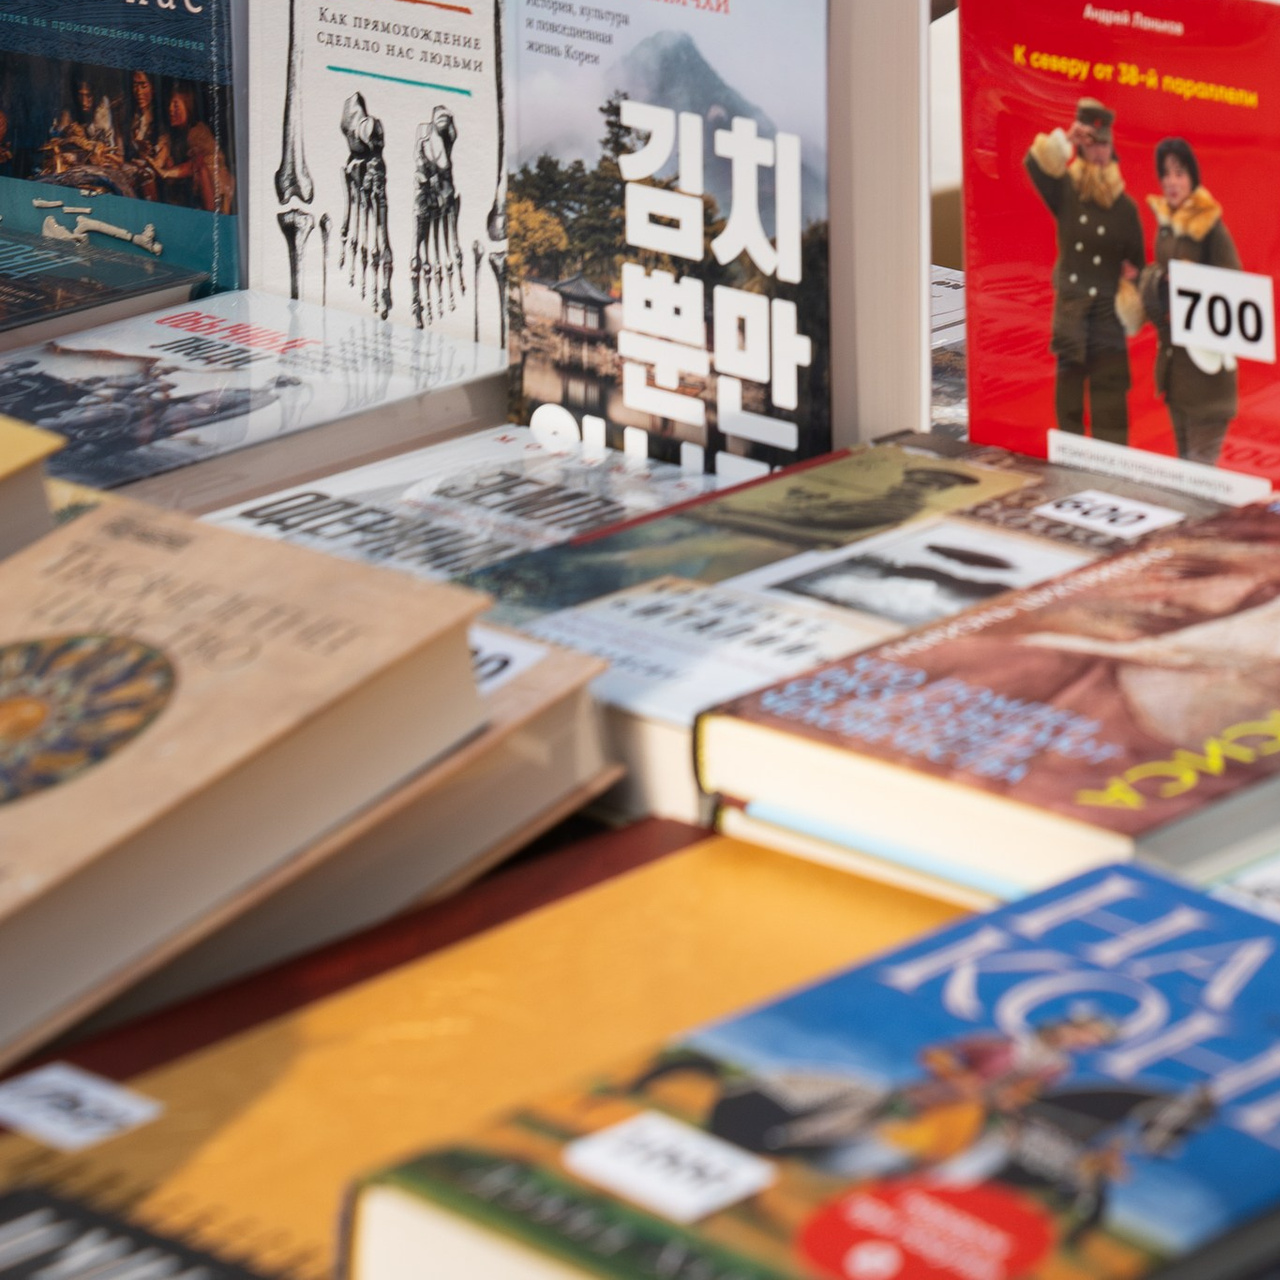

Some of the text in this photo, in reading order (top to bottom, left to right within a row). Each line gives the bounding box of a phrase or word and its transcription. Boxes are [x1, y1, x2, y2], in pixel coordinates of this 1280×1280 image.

[32, 16, 48, 28] на
[51, 20, 146, 42] происхождение
[150, 36, 206, 52] человека
[352, 16, 482, 51] ПРЯМОХОЖДЕНИЕ
[578, 3, 630, 28] культура
[1082, 3, 1185, 37] Андрей Ланьков
[316, 30, 484, 73] СДЕЛАЛО НАС ЛЮДЬМИ
[525, 39, 601, 66] жизнь Кореи
[1012, 43, 1259, 109] К северу от 38-й параллели
[618, 100, 802, 284] 김치
[155, 310, 324, 354] ОБЫЧНЫЕ
[1176, 288, 1264, 343] 700
[618, 262, 813, 452] 뿐만
[1053, 496, 1148, 528] 600
[1008, 872, 1278, 1014] НА
